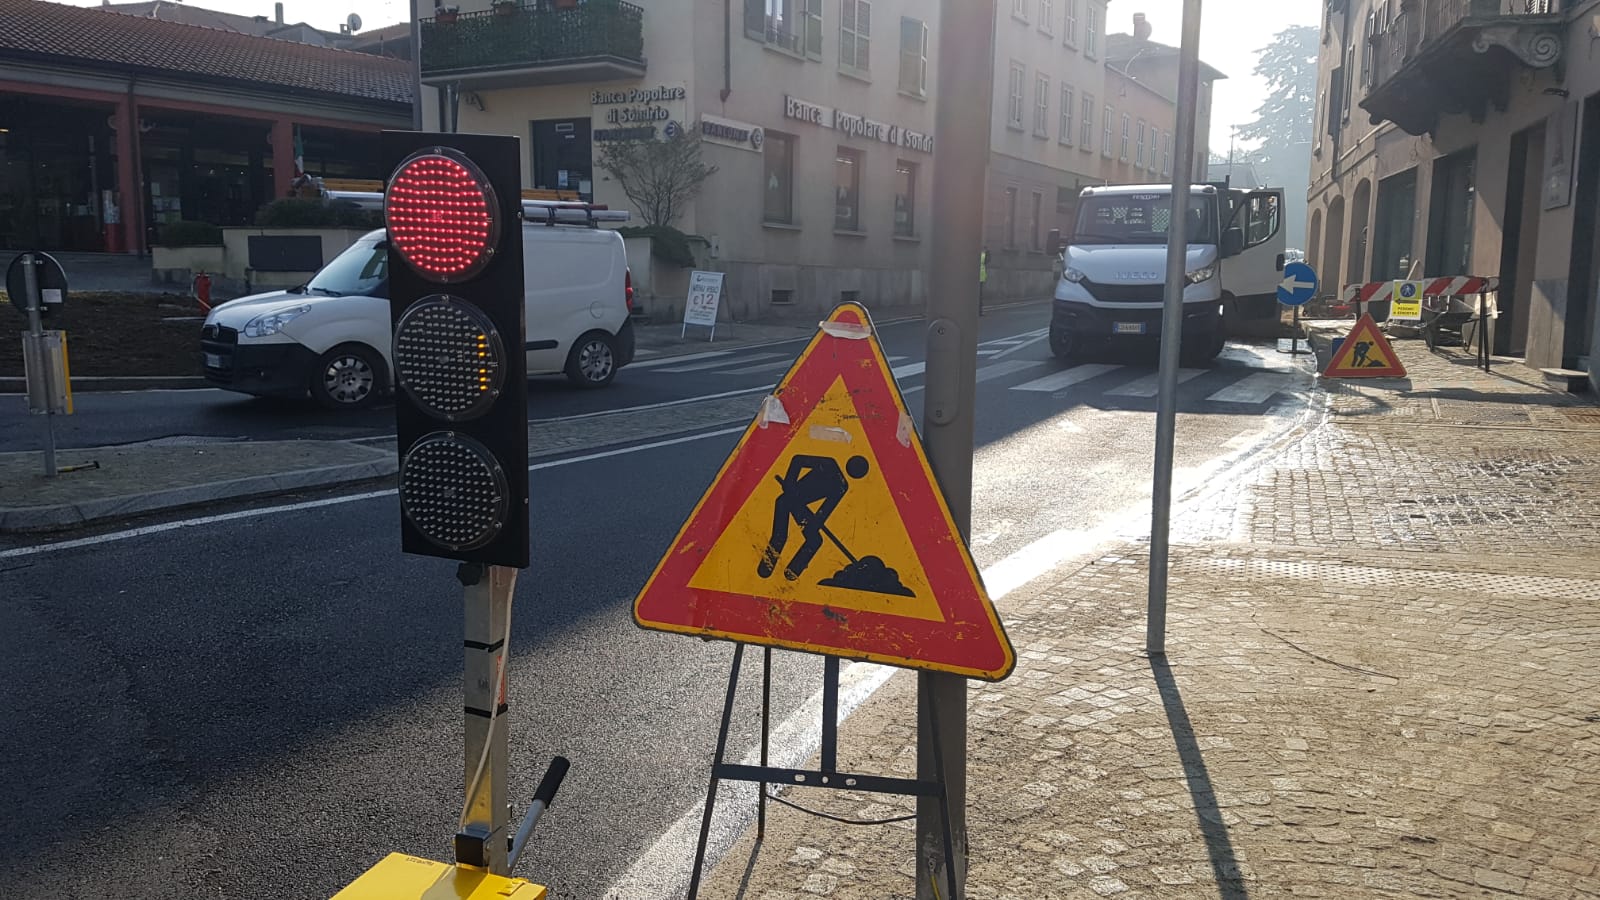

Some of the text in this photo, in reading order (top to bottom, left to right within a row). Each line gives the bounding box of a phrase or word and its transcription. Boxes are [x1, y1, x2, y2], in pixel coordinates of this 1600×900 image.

[591, 85, 685, 105] Banca Popolare
[607, 104, 669, 124] di Sondrio
[784, 95, 825, 124] Banca
[835, 109, 887, 142] Popolare
[1112, 271, 1159, 280] IVECO
